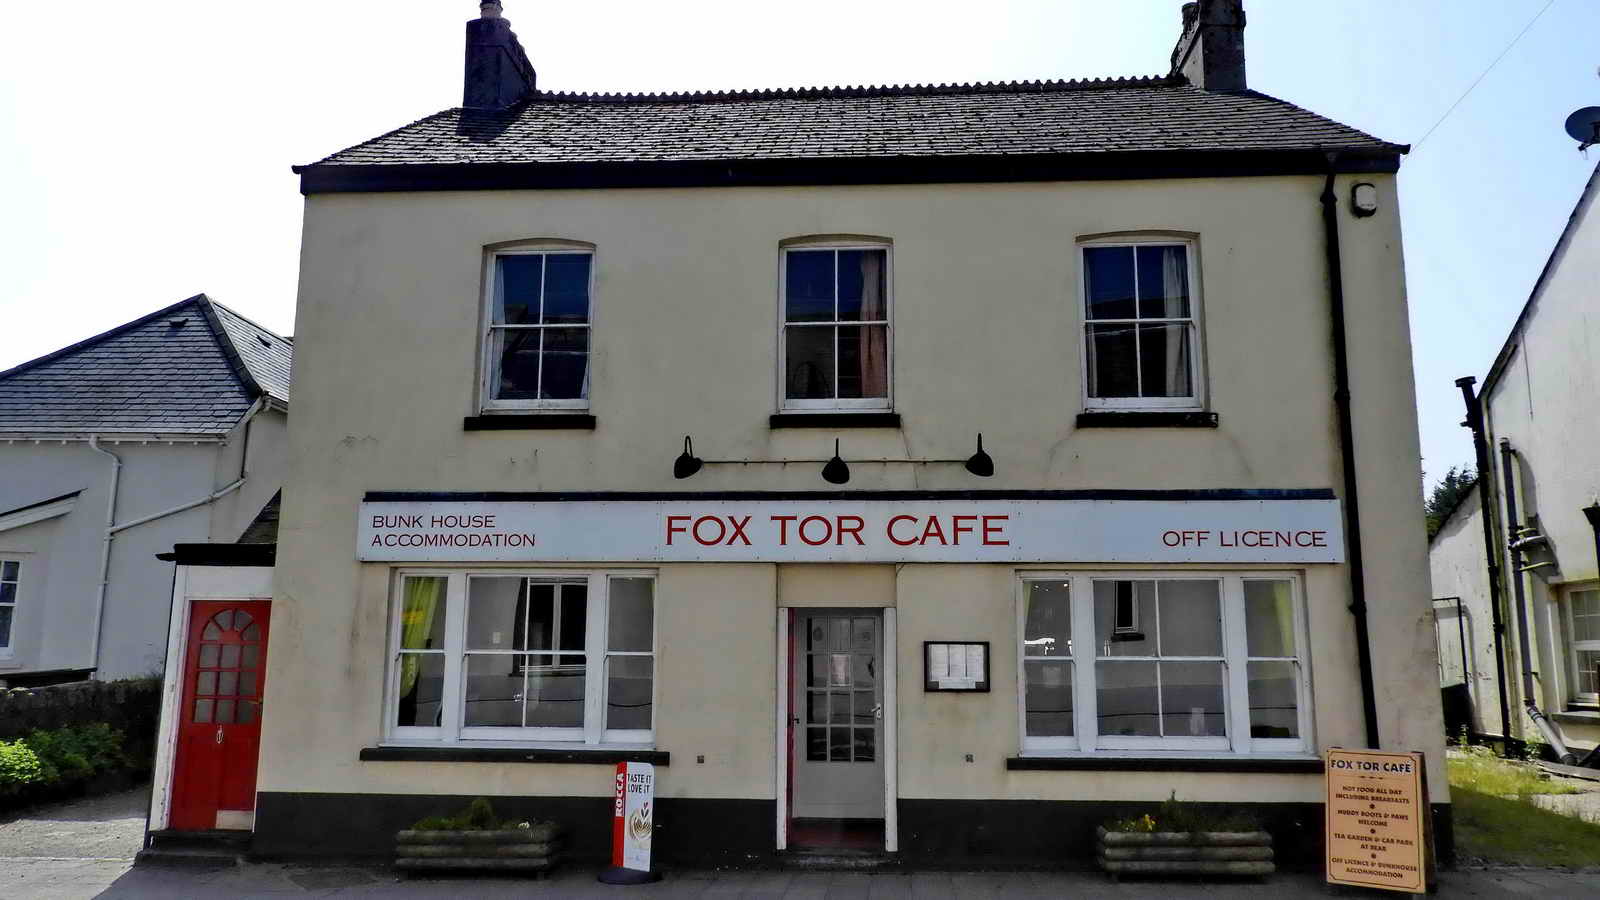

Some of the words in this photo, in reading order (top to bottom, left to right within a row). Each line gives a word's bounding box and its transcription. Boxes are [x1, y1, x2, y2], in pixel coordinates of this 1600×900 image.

[372, 515, 423, 529] BUNK
[430, 515, 496, 529] HOUSE
[664, 515, 752, 546] FOX
[770, 515, 865, 546] TOR
[886, 515, 1010, 546] CAFE
[371, 534, 536, 548] ACCOMMODATION
[1162, 530, 1211, 547] OFF
[1219, 530, 1328, 547] LICENCE
[1331, 759, 1353, 770] FOX
[1357, 761, 1380, 772] TOR
[627, 773, 645, 784] TASTE
[645, 775, 652, 784] IT
[627, 783, 642, 793] LOVE
[643, 784, 650, 793] IT
[615, 773, 625, 816] ROCCA
[1335, 793, 1370, 801] INCLUDING
[1337, 809, 1360, 817] MUDDY
[1361, 811, 1382, 819] BOOTS
[1358, 819, 1388, 827] WELCOME
[1347, 834, 1373, 843] GARDEN
[1382, 837, 1395, 845] CAR
[1396, 839, 1414, 847] PARK
[1344, 859, 1369, 867] LICENCE
[1346, 868, 1403, 878] ACCOMMODATION
